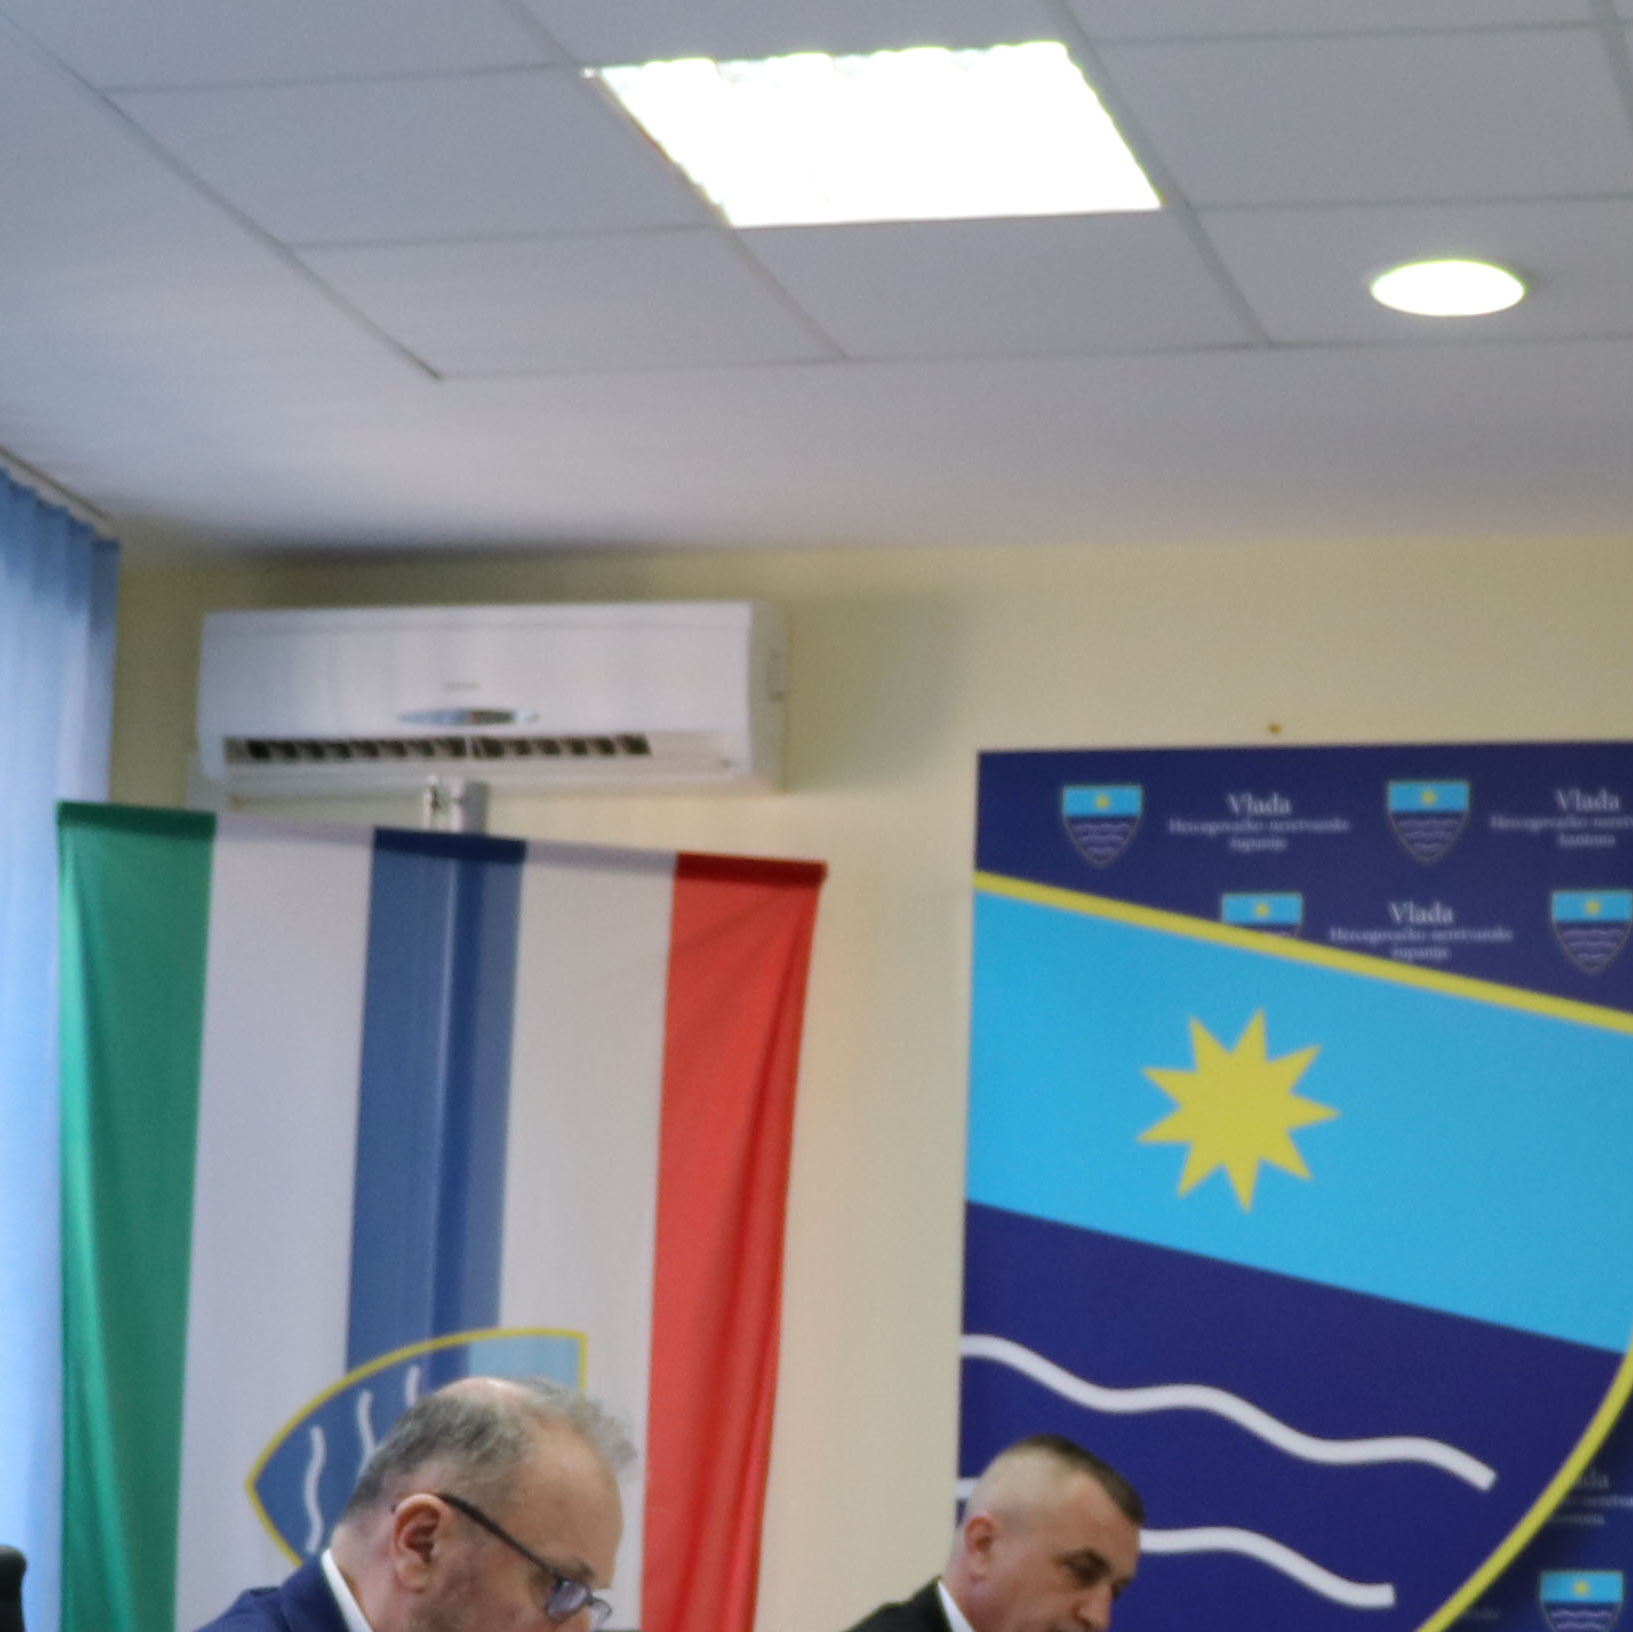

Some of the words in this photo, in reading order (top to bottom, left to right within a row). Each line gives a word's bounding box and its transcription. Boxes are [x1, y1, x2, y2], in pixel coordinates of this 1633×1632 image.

[1228, 792, 1292, 818] Vlada
[1555, 788, 1621, 814] Vlada
[1389, 901, 1454, 927] Vlada
